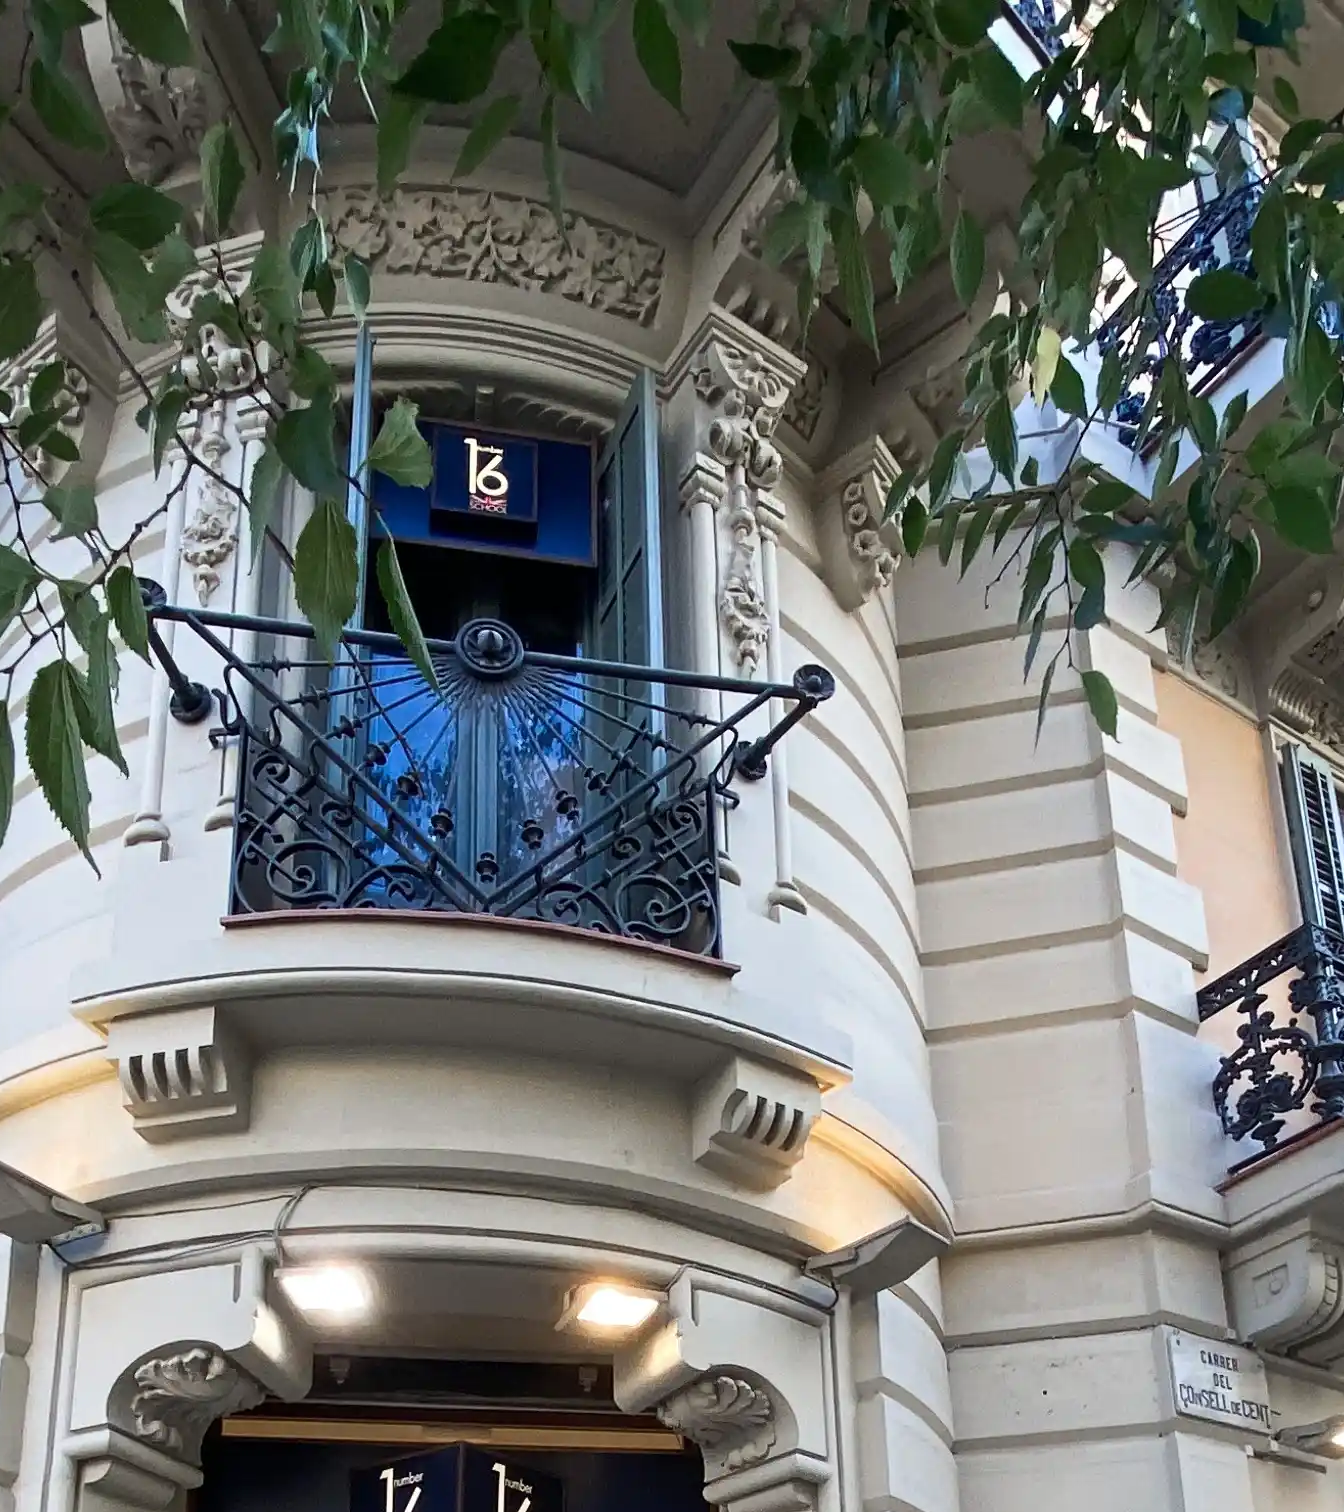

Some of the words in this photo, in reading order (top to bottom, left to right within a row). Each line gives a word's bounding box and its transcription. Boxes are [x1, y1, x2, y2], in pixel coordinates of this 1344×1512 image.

[463, 437, 509, 497] 16
[1200, 1349, 1240, 1372] CARRER
[1213, 1372, 1233, 1391] DEL
[1179, 1383, 1231, 1414] CONSELL
[1241, 1399, 1282, 1429] CENT
[393, 1472, 424, 1488] number
[504, 1478, 533, 1495] number
